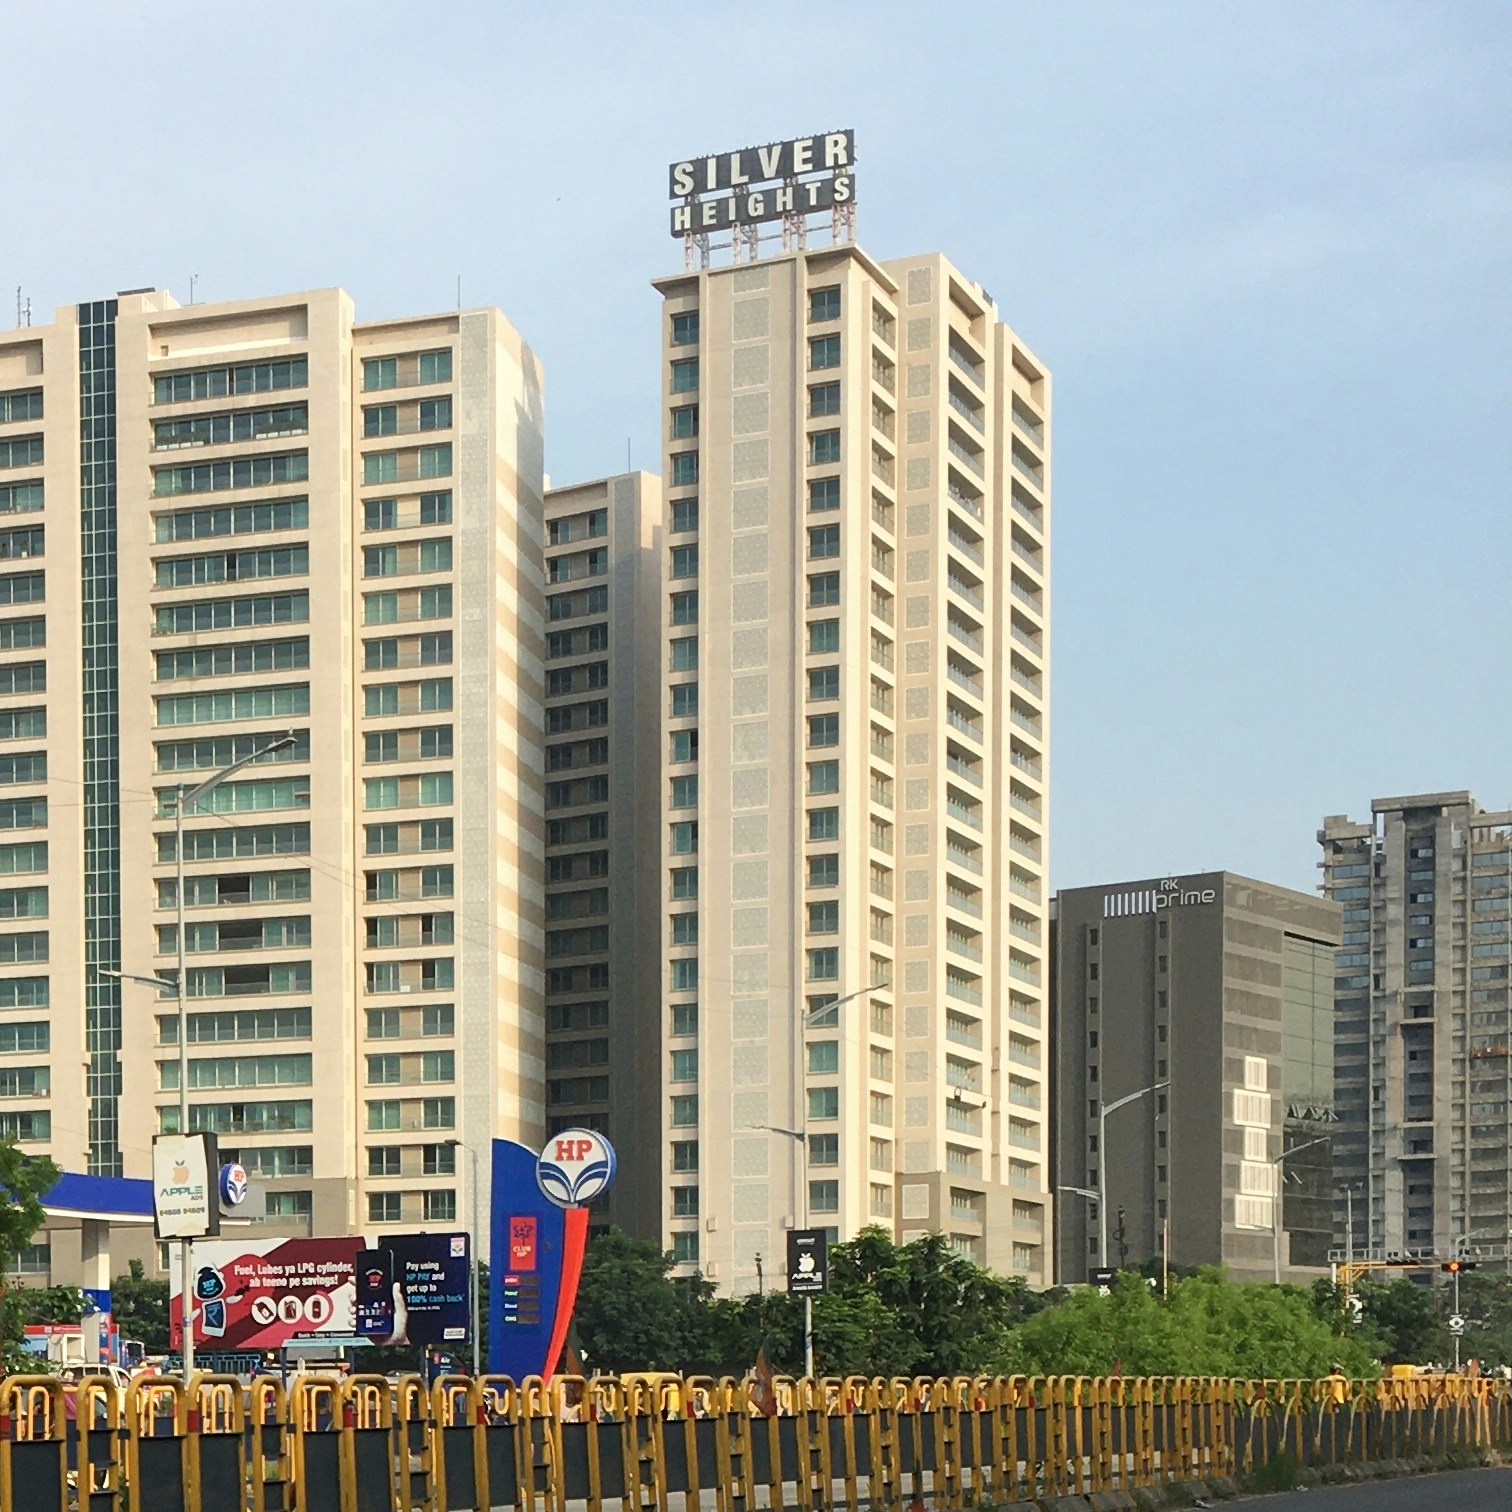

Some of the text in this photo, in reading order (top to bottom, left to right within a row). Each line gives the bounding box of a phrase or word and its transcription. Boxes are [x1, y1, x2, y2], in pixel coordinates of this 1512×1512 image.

[674, 133, 848, 196] SILVER
[674, 177, 850, 231] HEIGHTS
[1160, 879, 1179, 891] RK
[555, 1139, 593, 1161] HP
[159, 1185, 204, 1198] APPLE
[234, 1264, 256, 1276] Fuel,
[257, 1264, 284, 1275] Lubes
[285, 1265, 296, 1276] ya
[297, 1262, 315, 1274] LPG
[316, 1261, 354, 1275] cylinder,
[406, 1261, 440, 1272] Pay using
[249, 1277, 261, 1287] ab
[289, 1278, 301, 1288] pe
[302, 1274, 339, 1288] savings!
[431, 1271, 445, 1281] and
[406, 1283, 438, 1294] get up to
[407, 1295, 428, 1304] 100%
[428, 1294, 446, 1303] cash
